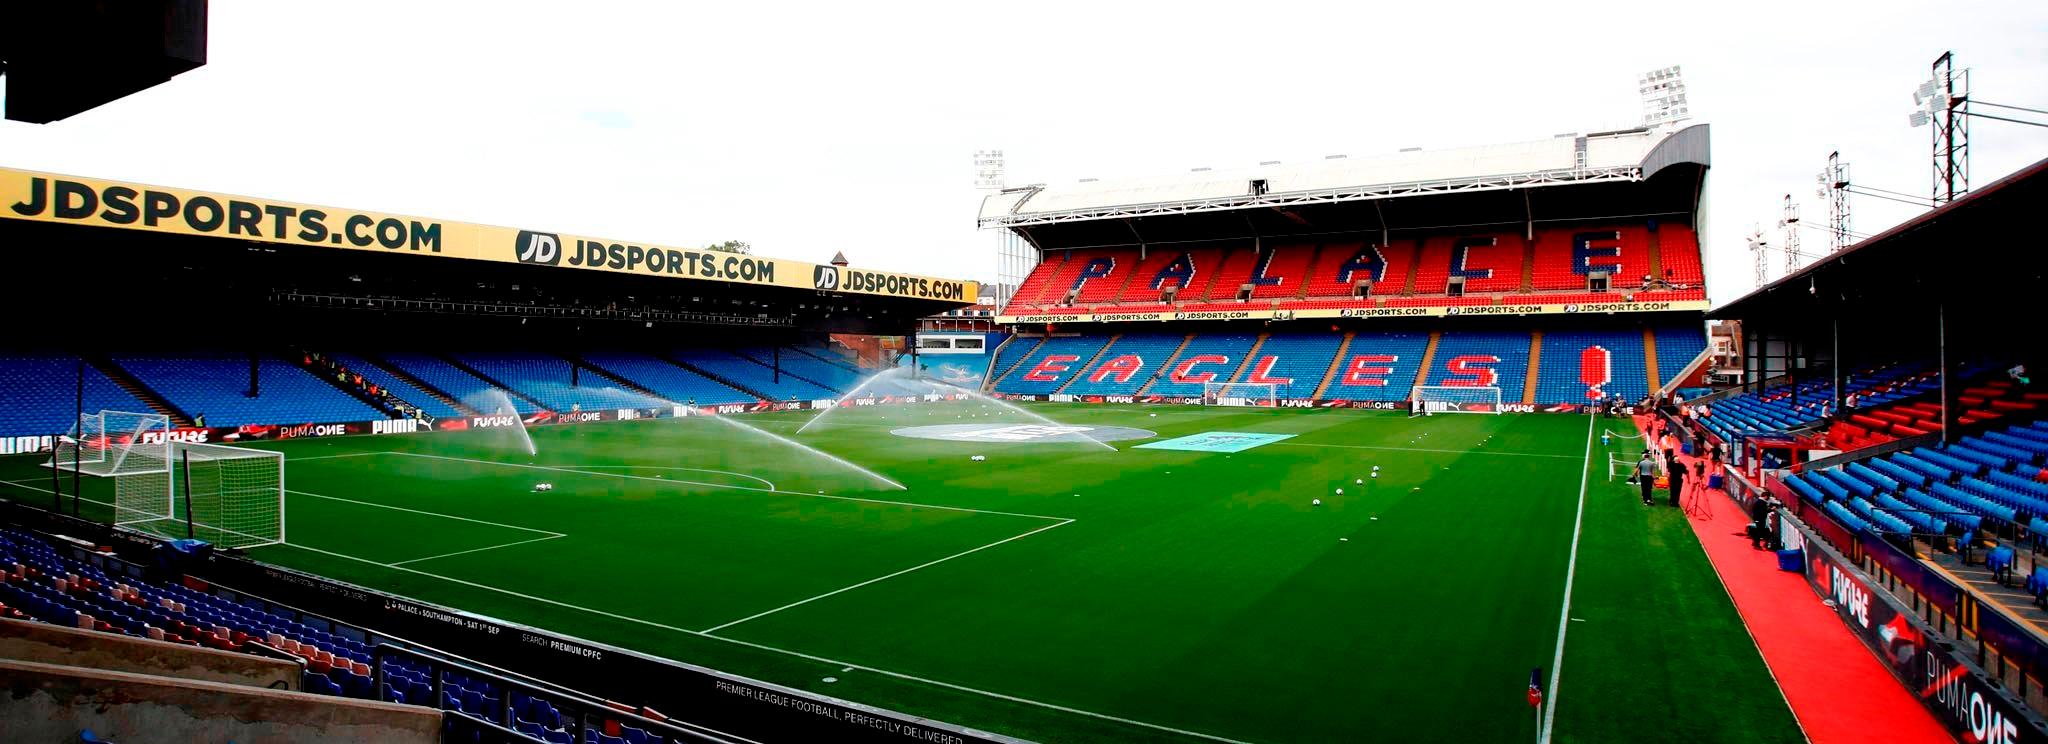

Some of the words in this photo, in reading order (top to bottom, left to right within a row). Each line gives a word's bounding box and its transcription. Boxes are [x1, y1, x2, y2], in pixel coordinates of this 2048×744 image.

[10, 178, 442, 253] JDSPORTS.COM
[520, 233, 559, 263] JD
[568, 240, 775, 283] JDSPORTS.COM
[816, 267, 838, 289] JD
[843, 270, 964, 301] JDSPORTS.COM
[1102, 313, 1160, 321] JDSPORTS.COM
[1354, 308, 1427, 317] JDSPORTS.COM
[1462, 306, 1542, 315] JDSPORTS.COM
[1580, 303, 1670, 312] JDSPORTS.COM
[372, 419, 417, 435] PUMA
[397, 602, 418, 616] PALACE
[422, 609, 463, 627] SOUTHAMPTON
[467, 620, 478, 631] SAT
[488, 625, 501, 636] SEP
[522, 633, 549, 648] SEARCH
[550, 640, 582, 656] PREMIUM
[582, 647, 602, 661] CPFC
[716, 680, 753, 699] PREMIER
[753, 690, 790, 708] LEAGUE
[791, 699, 843, 722] FOOTBALL,
[844, 711, 902, 734] PERFECTLY
